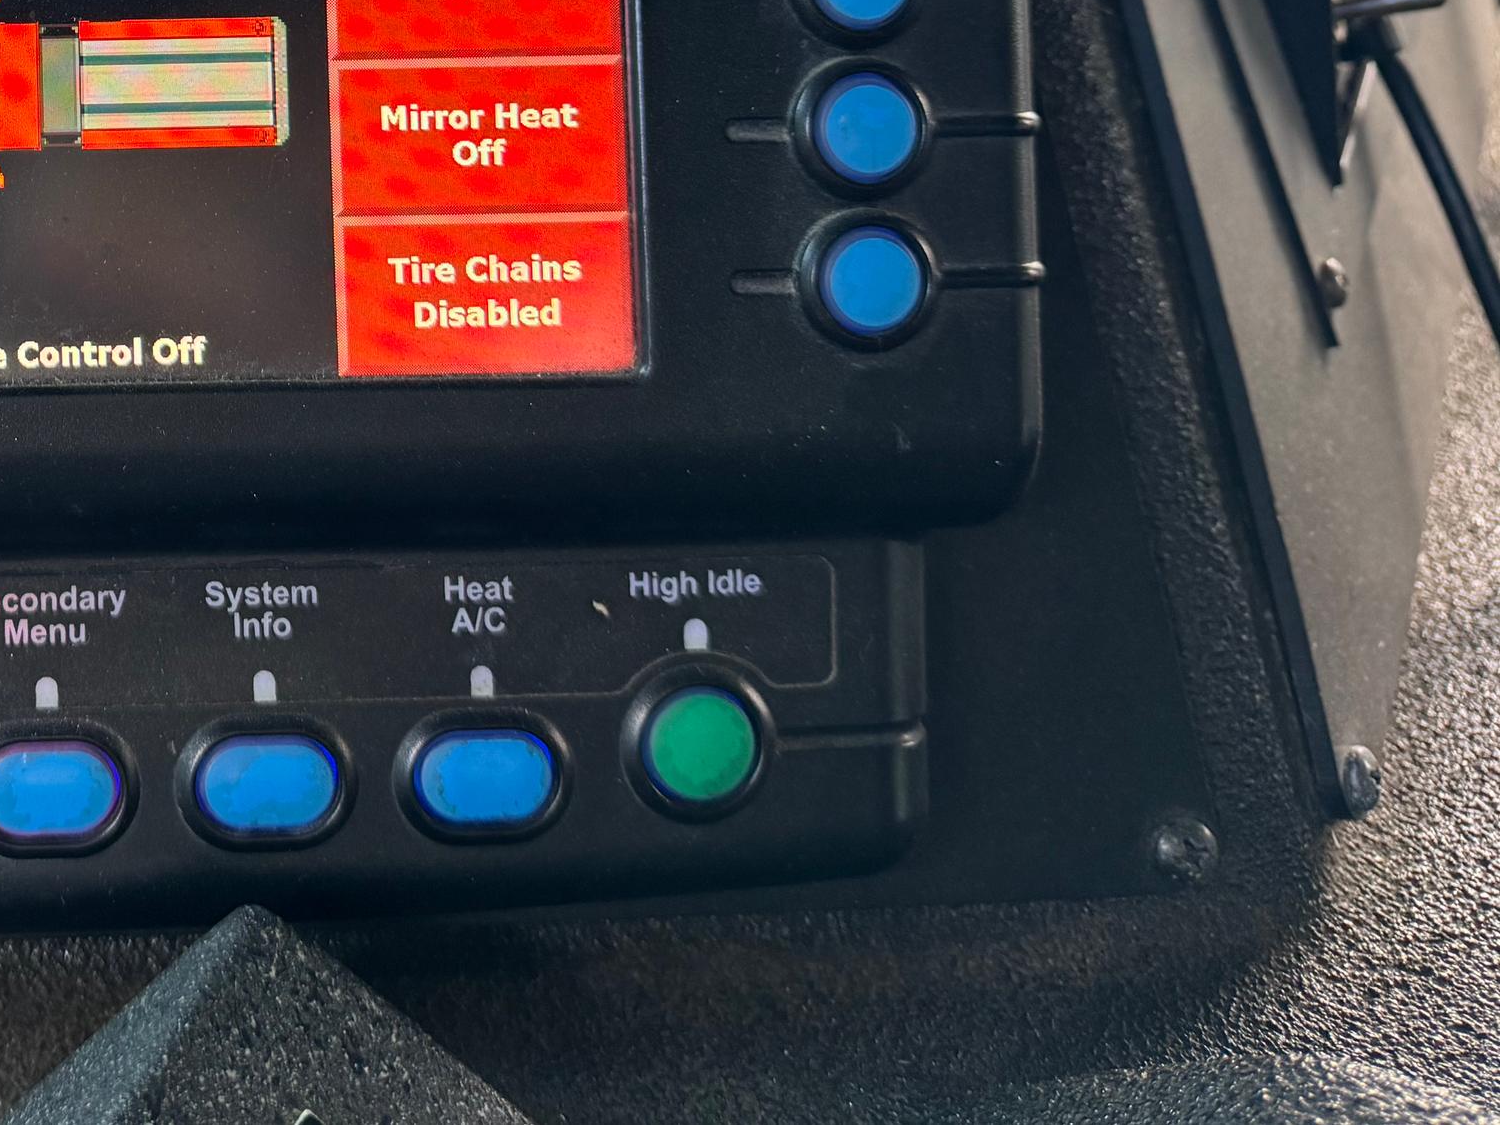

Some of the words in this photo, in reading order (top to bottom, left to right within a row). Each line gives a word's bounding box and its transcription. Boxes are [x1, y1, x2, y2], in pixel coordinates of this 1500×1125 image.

[380, 103, 485, 132] Mirror
[495, 102, 579, 130] Heat
[452, 138, 507, 167] Off
[387, 255, 456, 285] Tire
[465, 253, 582, 283] Chains
[414, 297, 562, 329] Disabled
[17, 336, 143, 369] Control
[152, 335, 208, 366] Off
[205, 580, 318, 613] System
[444, 575, 513, 602] Heat
[629, 570, 698, 604] High
[708, 568, 762, 595] Idle
[4, 618, 86, 646] Menu
[233, 611, 292, 639] Info
[451, 606, 505, 634] A/C
